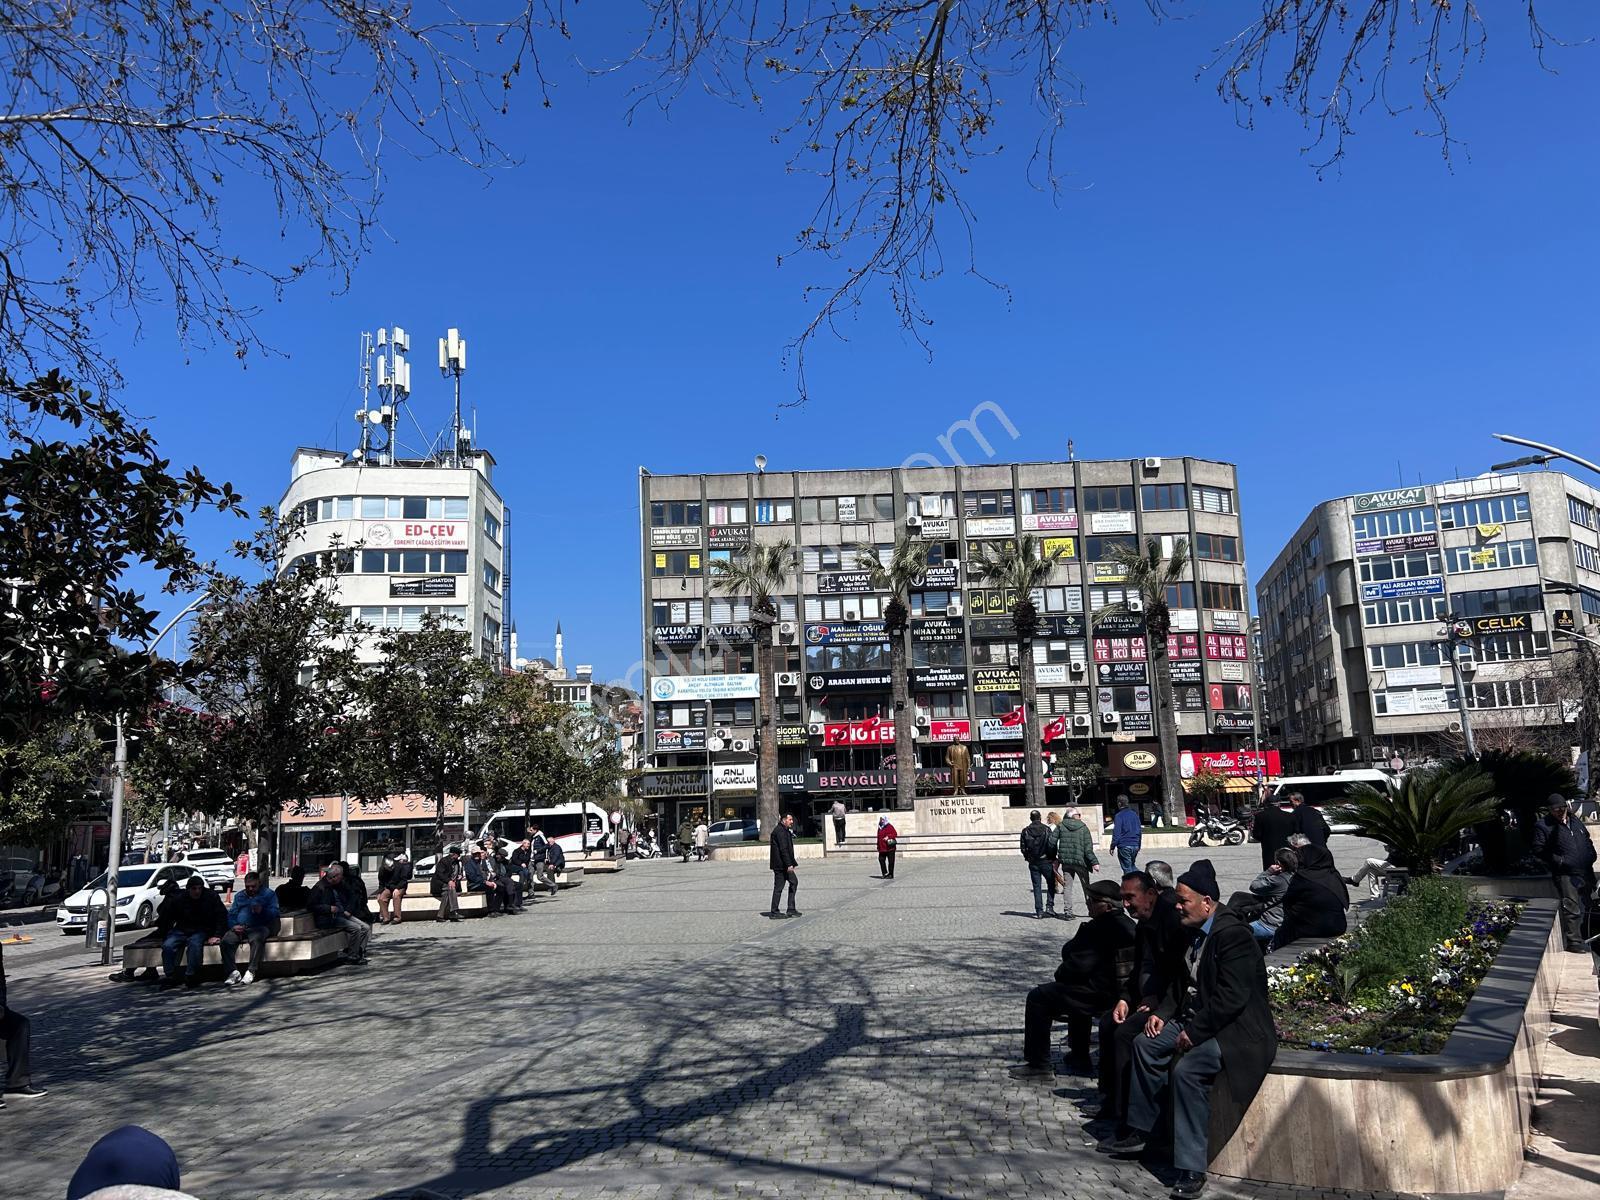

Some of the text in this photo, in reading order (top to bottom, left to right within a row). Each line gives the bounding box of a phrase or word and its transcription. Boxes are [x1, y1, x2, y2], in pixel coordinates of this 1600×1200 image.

[1370, 488, 1422, 504] AVUKAT
[405, 524, 454, 539] ED-ÇEV
[717, 528, 748, 536] AVUKAT
[1214, 612, 1238, 620] AVUKAT
[655, 626, 700, 635] AVUKAT
[708, 626, 753, 635] AVUKAT
[914, 627, 937, 635] NİHAN
[1096, 637, 1144, 648] AL MAN CA
[1208, 636, 1244, 646] AL MAN CA
[1097, 647, 1146, 658] TE RCÜ ME
[1209, 647, 1217, 656] TE
[1236, 648, 1246, 657] ME
[1216, 719, 1236, 727] PUSULA
[776, 726, 806, 735] SİGORTA
[990, 759, 1019, 769] ZEYTİN
[1201, 756, 1234, 768] Nadide
[988, 769, 1020, 778] ZEYTİNYAĞI
[777, 774, 804, 784] RGELLO
[820, 772, 886, 787] BEYOĞLU
